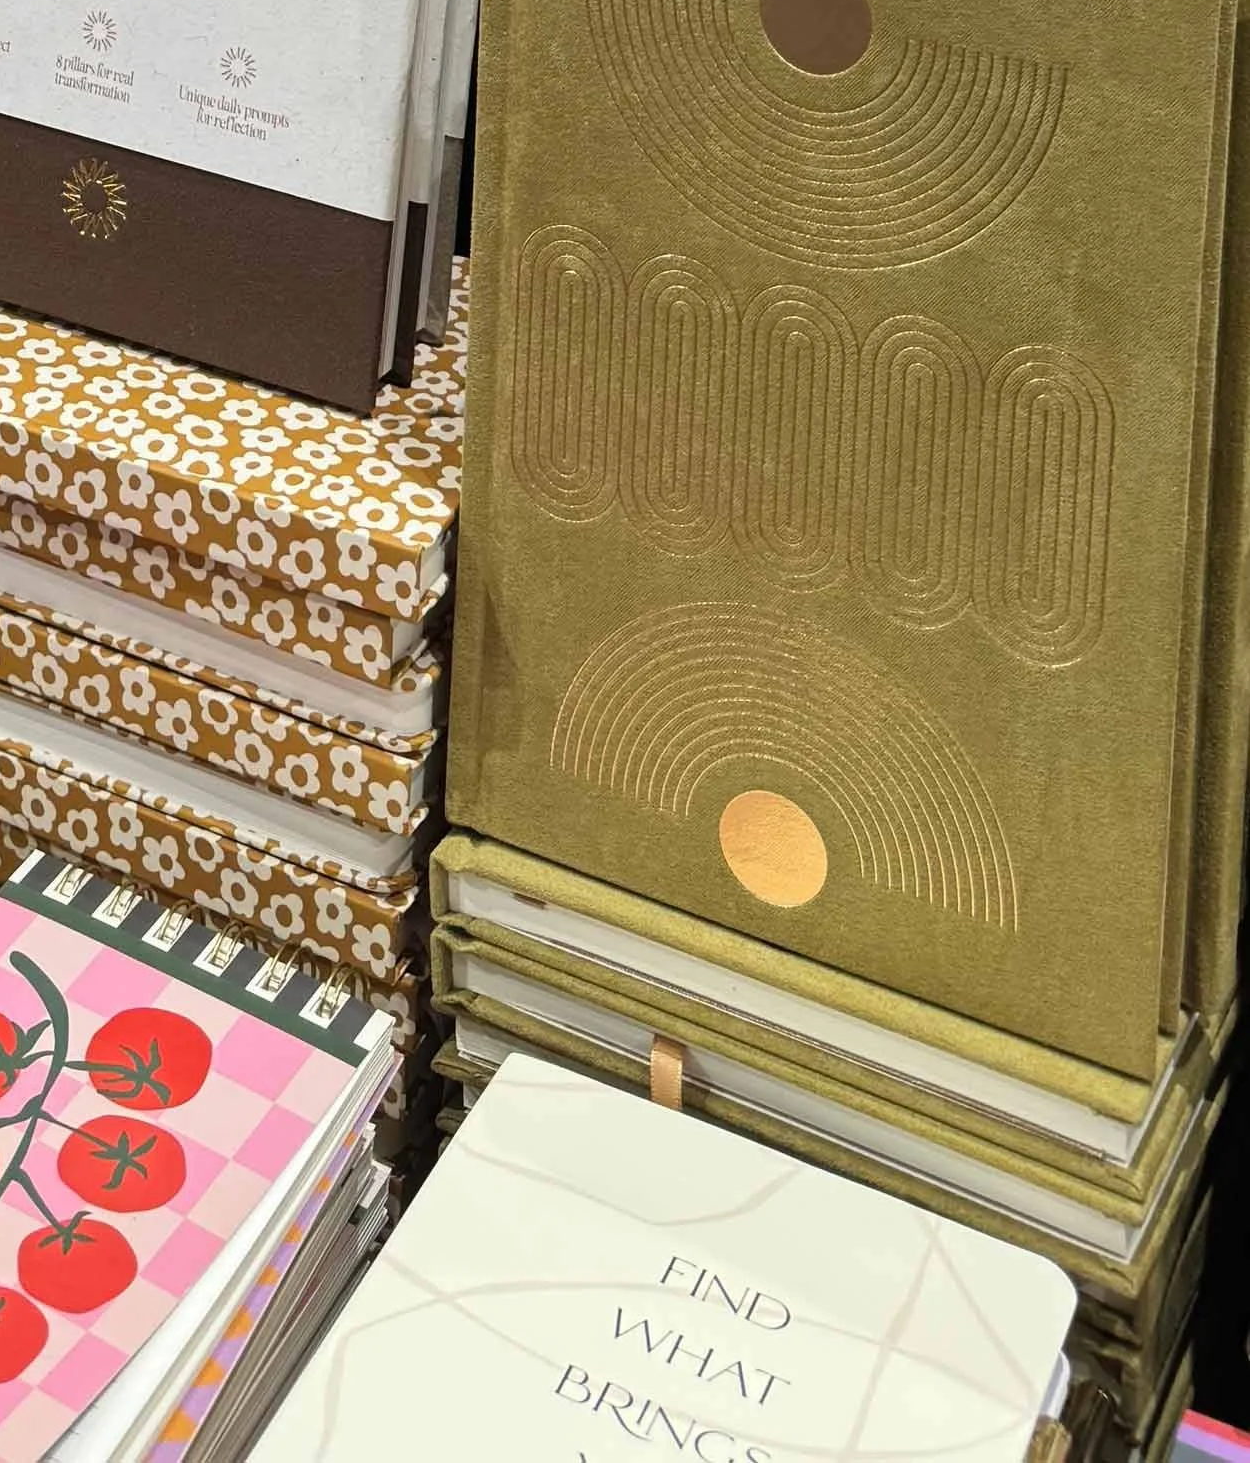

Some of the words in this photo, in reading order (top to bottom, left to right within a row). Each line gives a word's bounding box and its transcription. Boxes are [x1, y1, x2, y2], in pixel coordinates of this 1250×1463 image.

[54, 72, 130, 103] transformation
[55, 55, 62, 68] 8
[63, 56, 96, 75] pillars
[97, 63, 112, 79] for
[113, 70, 134, 86] real
[179, 85, 217, 109] Unique
[244, 106, 290, 129] prompts
[197, 109, 212, 125] for
[214, 115, 267, 141] reflection
[660, 1256, 791, 1331] FIND
[614, 1306, 792, 1405] WHAT
